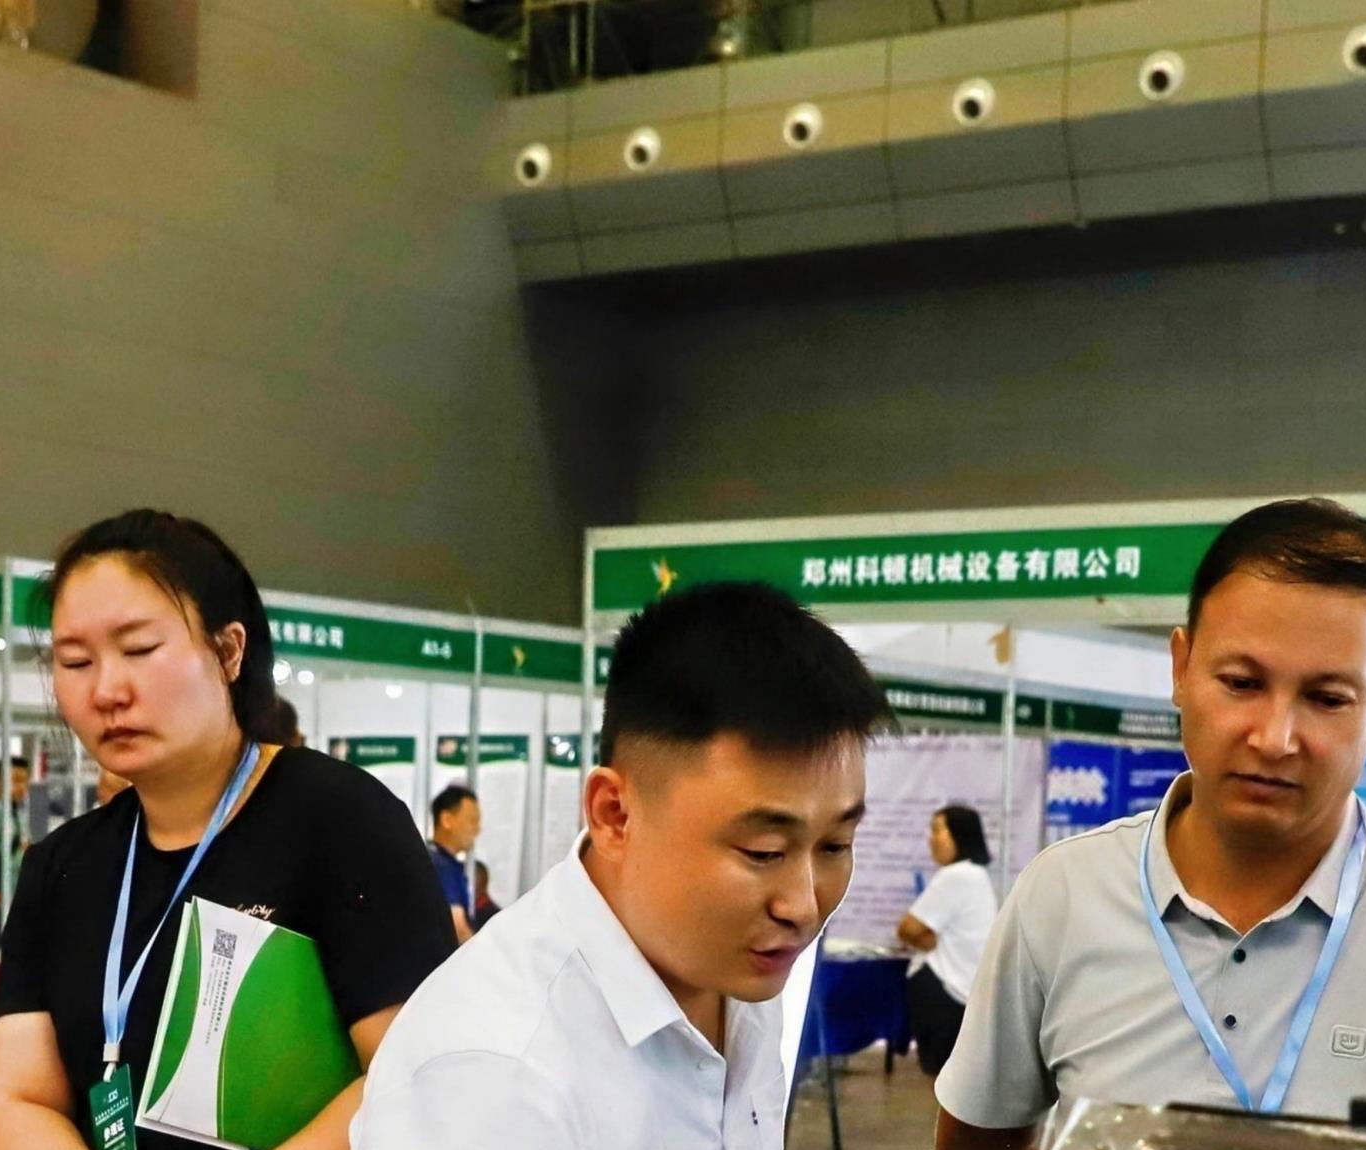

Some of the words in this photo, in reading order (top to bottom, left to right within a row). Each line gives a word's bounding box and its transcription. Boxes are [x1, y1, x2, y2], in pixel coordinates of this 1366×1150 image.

[801, 546, 1141, 586] 郑州科顿机械设备有限公司
